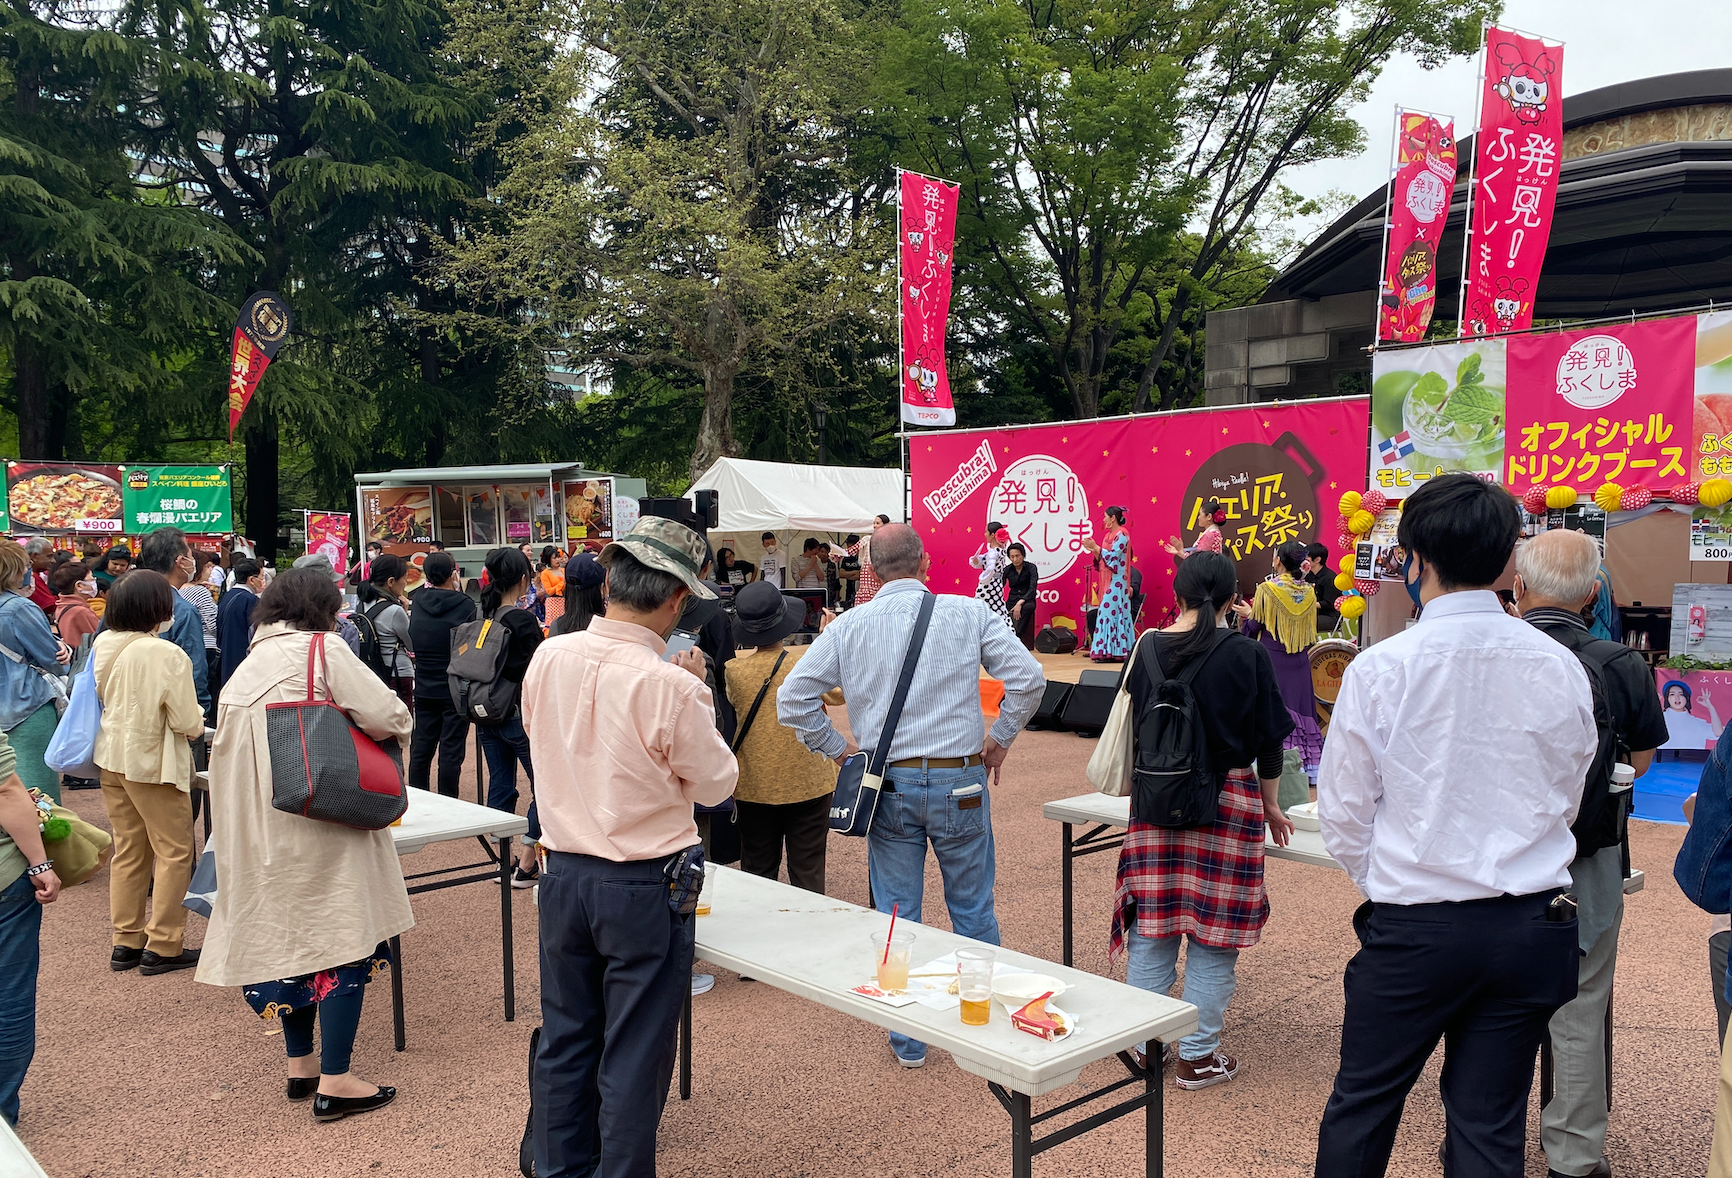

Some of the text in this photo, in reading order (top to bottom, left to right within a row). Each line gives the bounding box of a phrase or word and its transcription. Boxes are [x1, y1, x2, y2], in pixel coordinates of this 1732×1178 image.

[1516, 175, 1548, 185] はっけん
[1565, 346, 1625, 372] 発見!
[1558, 369, 1636, 394] ふくしま
[1520, 413, 1674, 452] オフィシャル
[931, 448, 987, 507] Descubra!
[1508, 447, 1686, 486] ドリンクブース
[160, 499, 198, 510] 桜鯛の
[940, 468, 989, 515] Fukushima
[998, 476, 1076, 514] 発見!
[82, 520, 115, 529] ¥900
[1003, 519, 1091, 553] くしま
[1199, 504, 1313, 561] パス祭り
